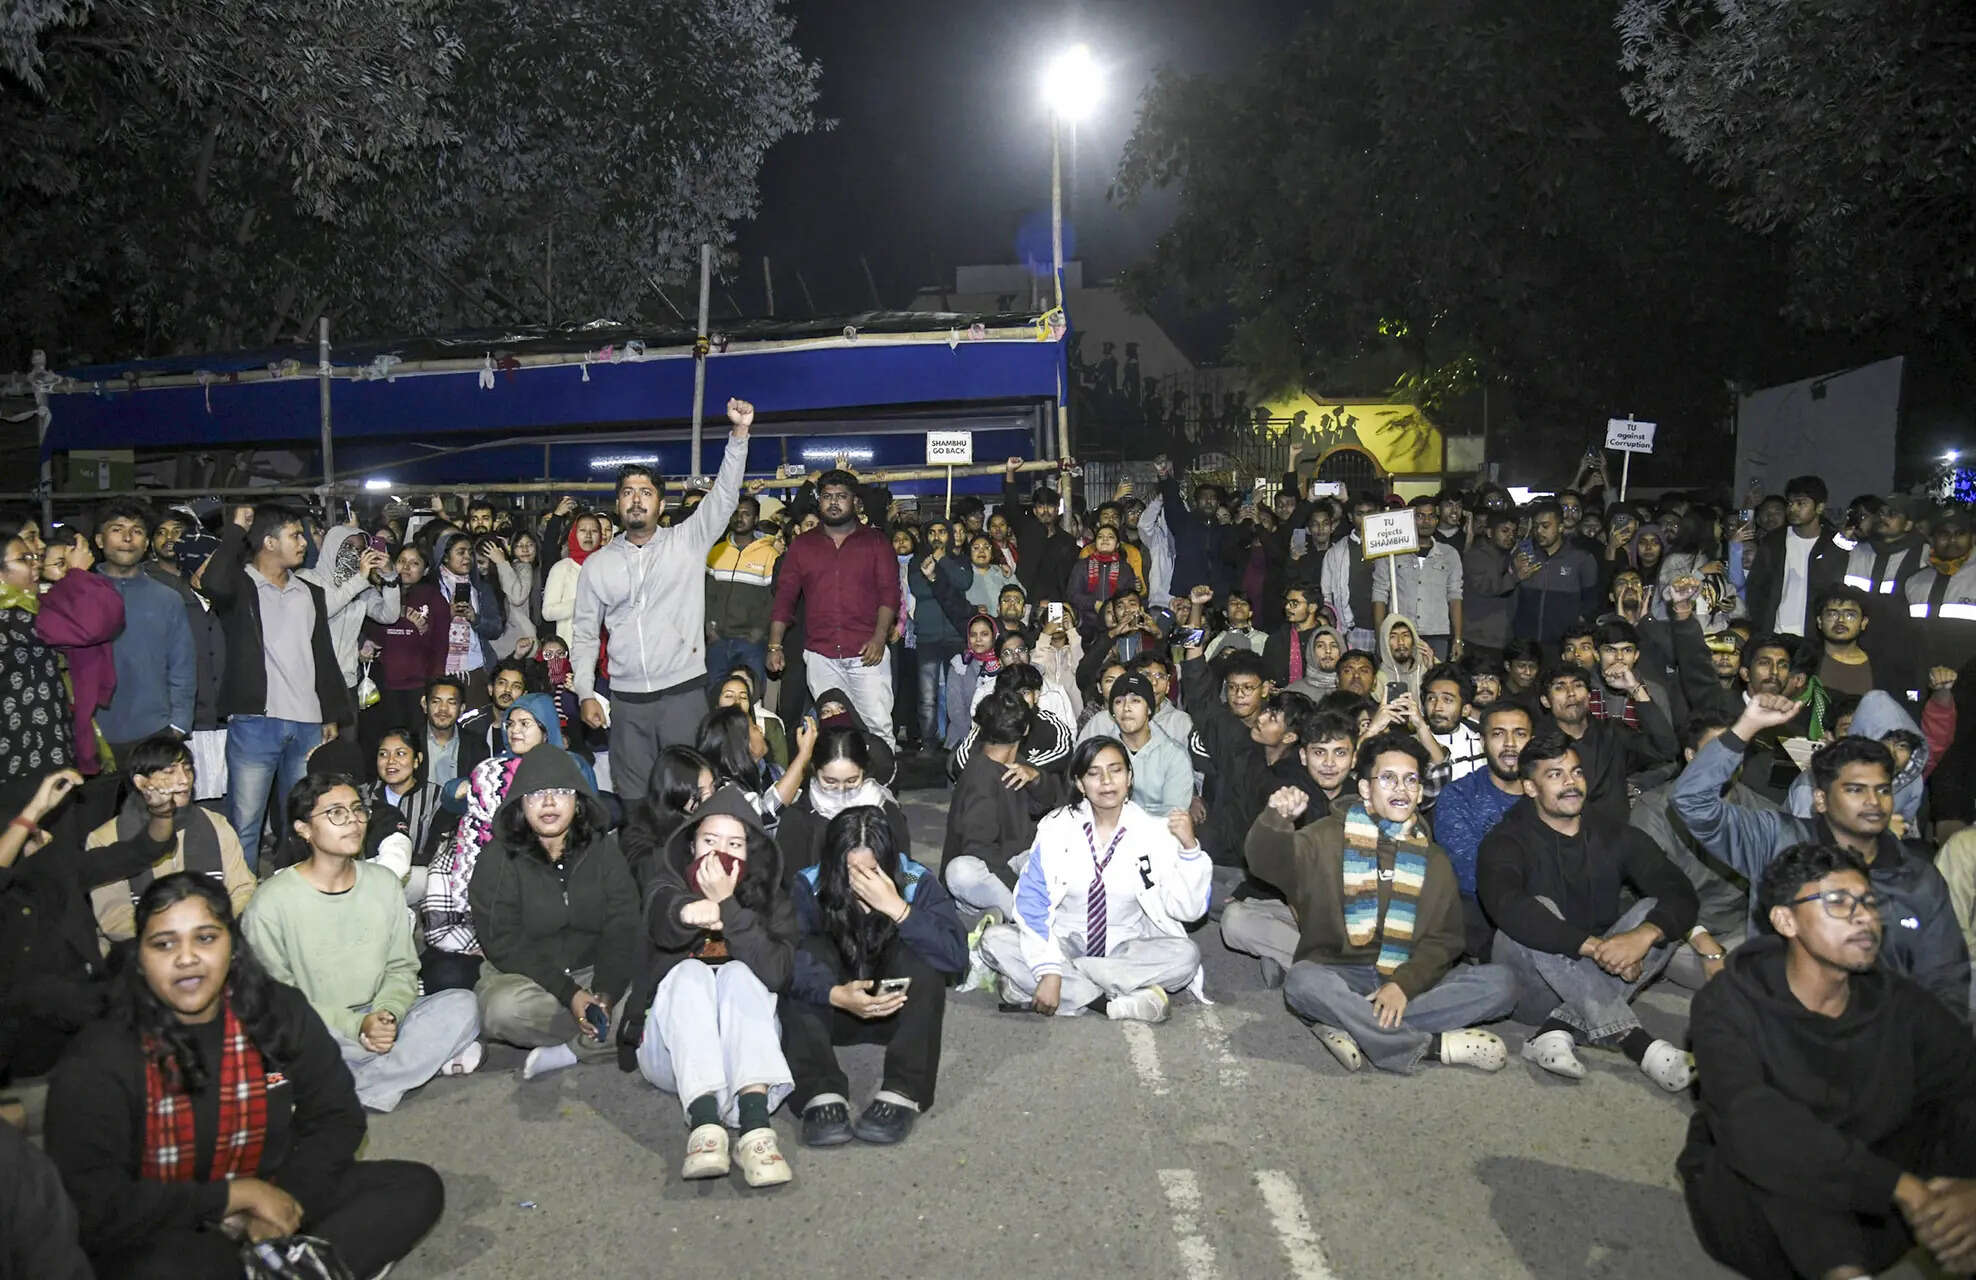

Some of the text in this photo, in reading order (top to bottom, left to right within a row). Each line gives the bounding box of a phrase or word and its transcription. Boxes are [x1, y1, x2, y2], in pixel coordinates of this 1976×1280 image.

[1617, 432, 1645, 440] against
[1610, 439, 1650, 448] Corruption
[1377, 528, 1402, 538] rejects
[1370, 536, 1409, 548] SHAMBHU
